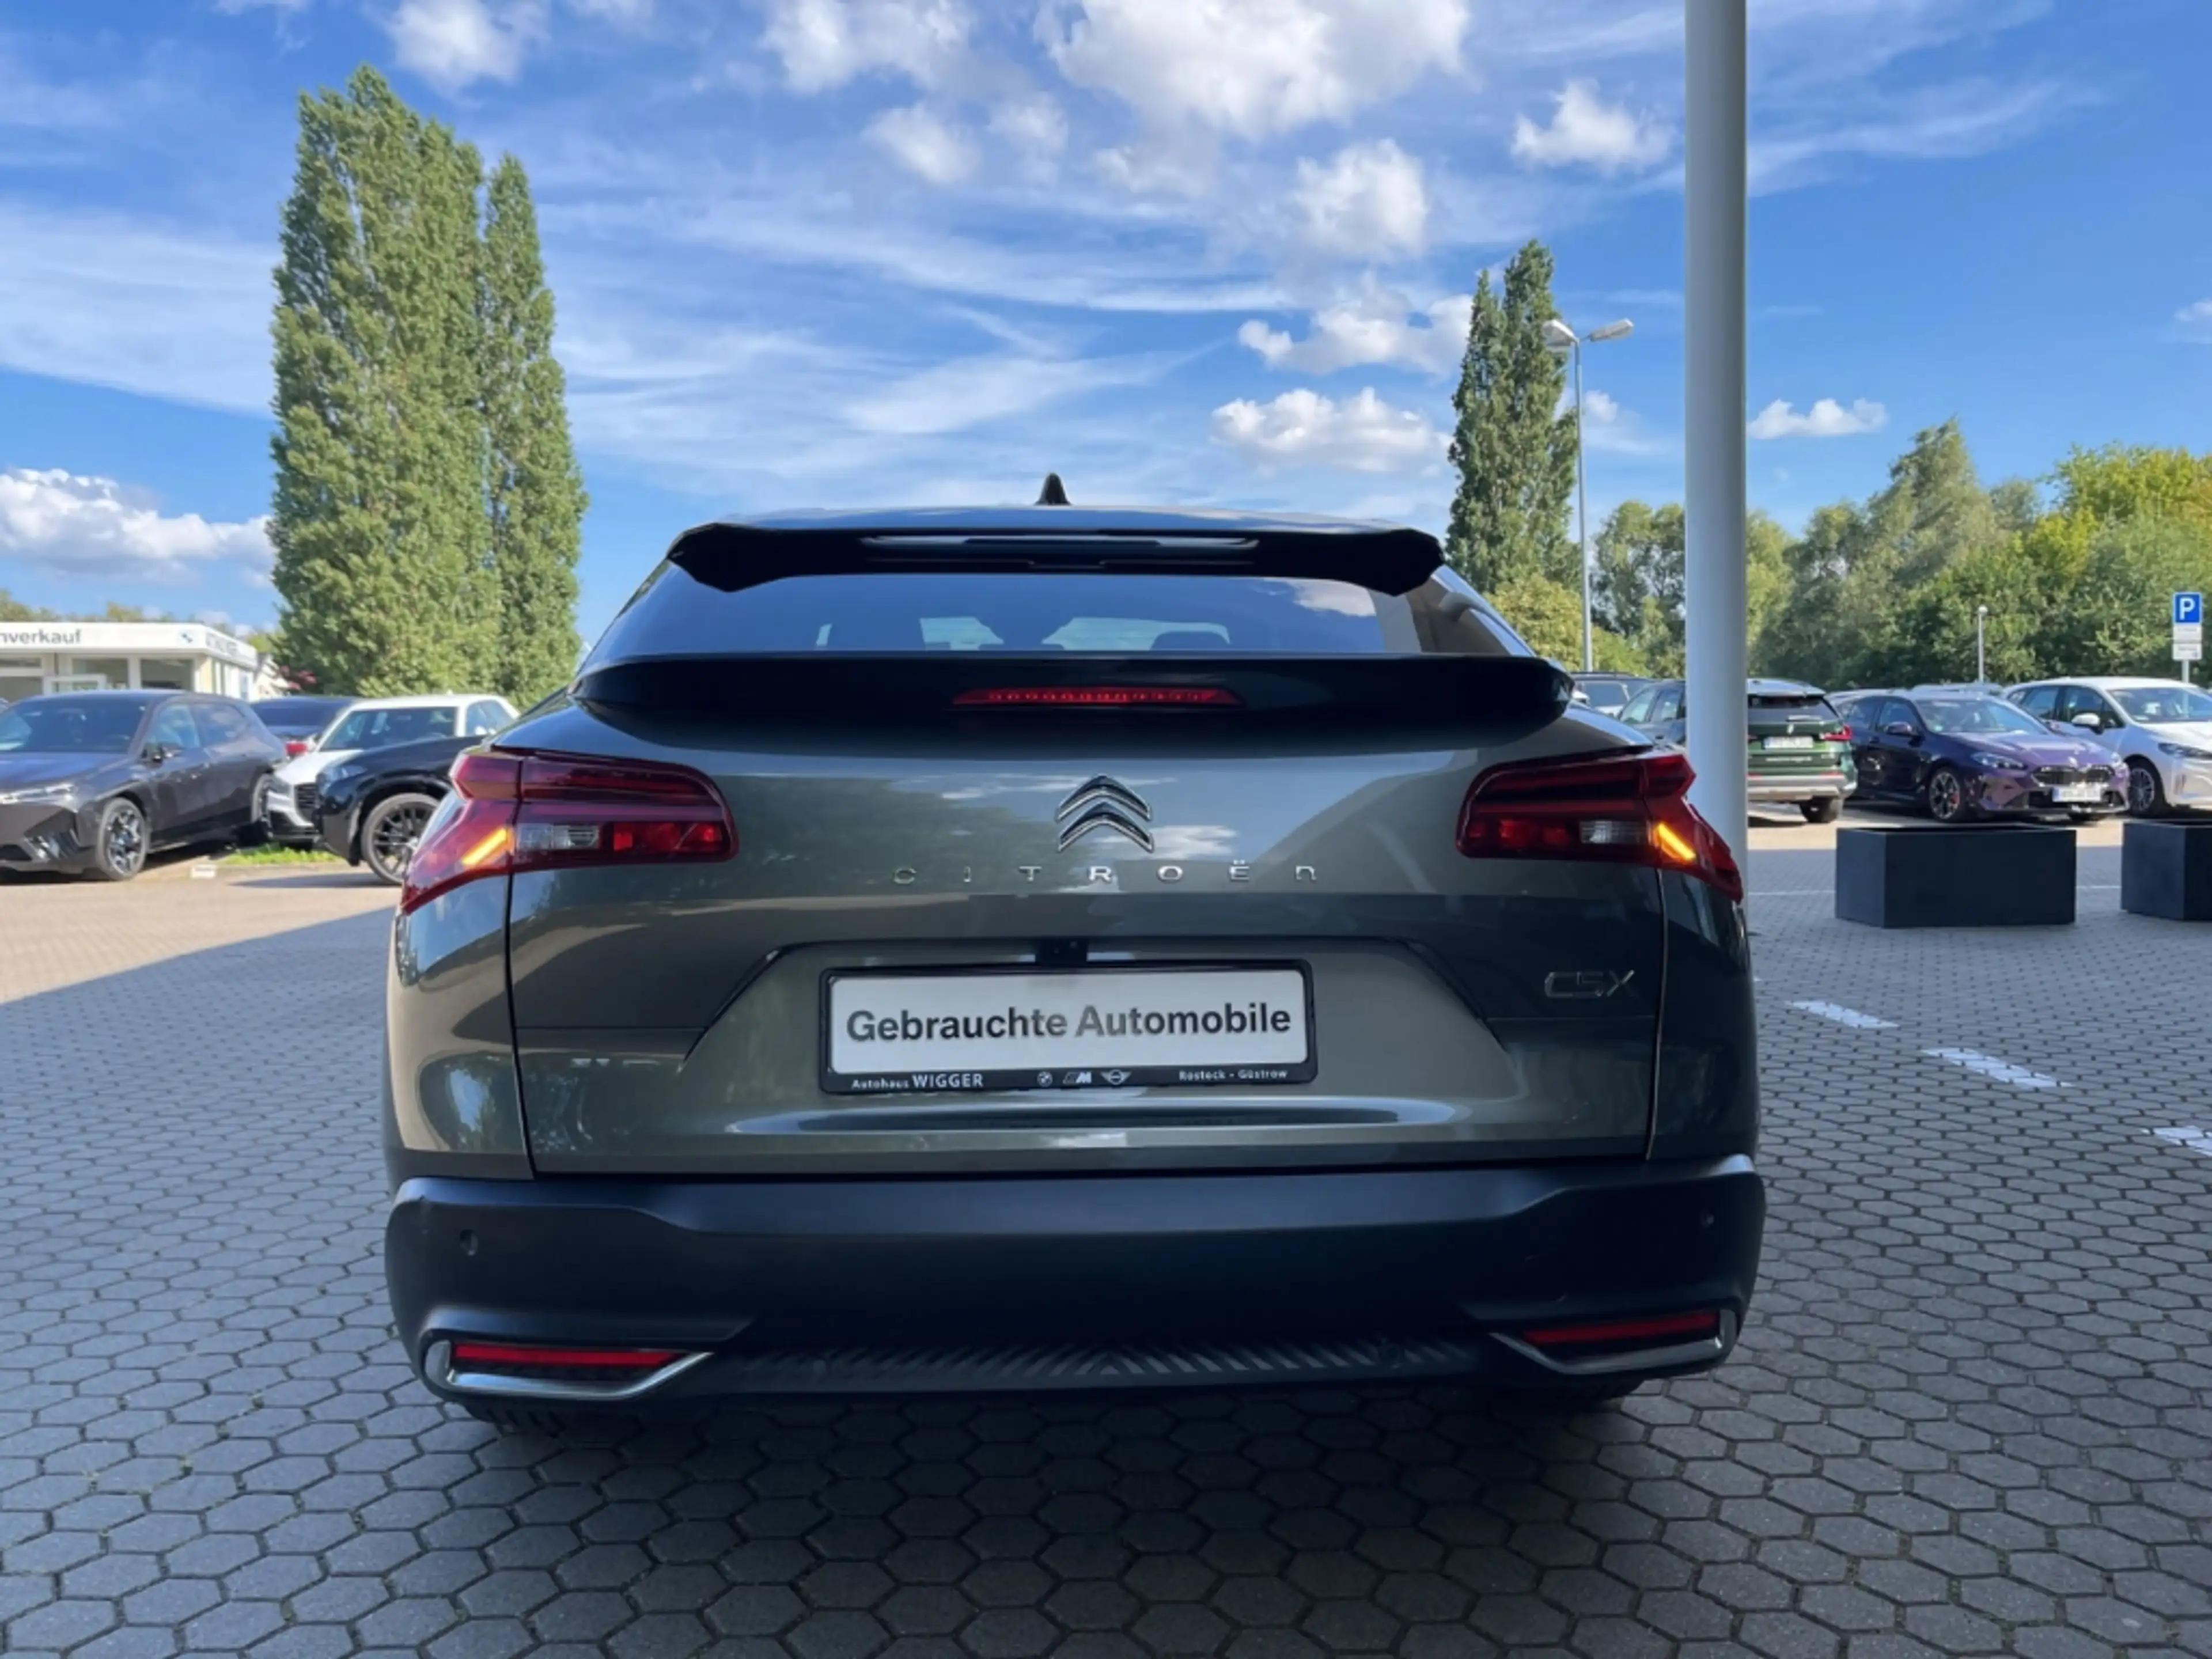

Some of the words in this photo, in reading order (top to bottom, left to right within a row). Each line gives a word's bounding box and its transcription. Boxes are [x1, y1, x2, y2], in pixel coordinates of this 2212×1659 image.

[2179, 598, 2195, 620] P
[846, 1006, 1068, 1041] Gebrauchte
[1075, 1002, 1291, 1037] Automobile
[851, 1078, 909, 1089] Autohaus
[911, 1073, 984, 1088] WIGGER
[1179, 1070, 1226, 1081] Rostock
[1238, 1069, 1288, 1079] Güstrow
